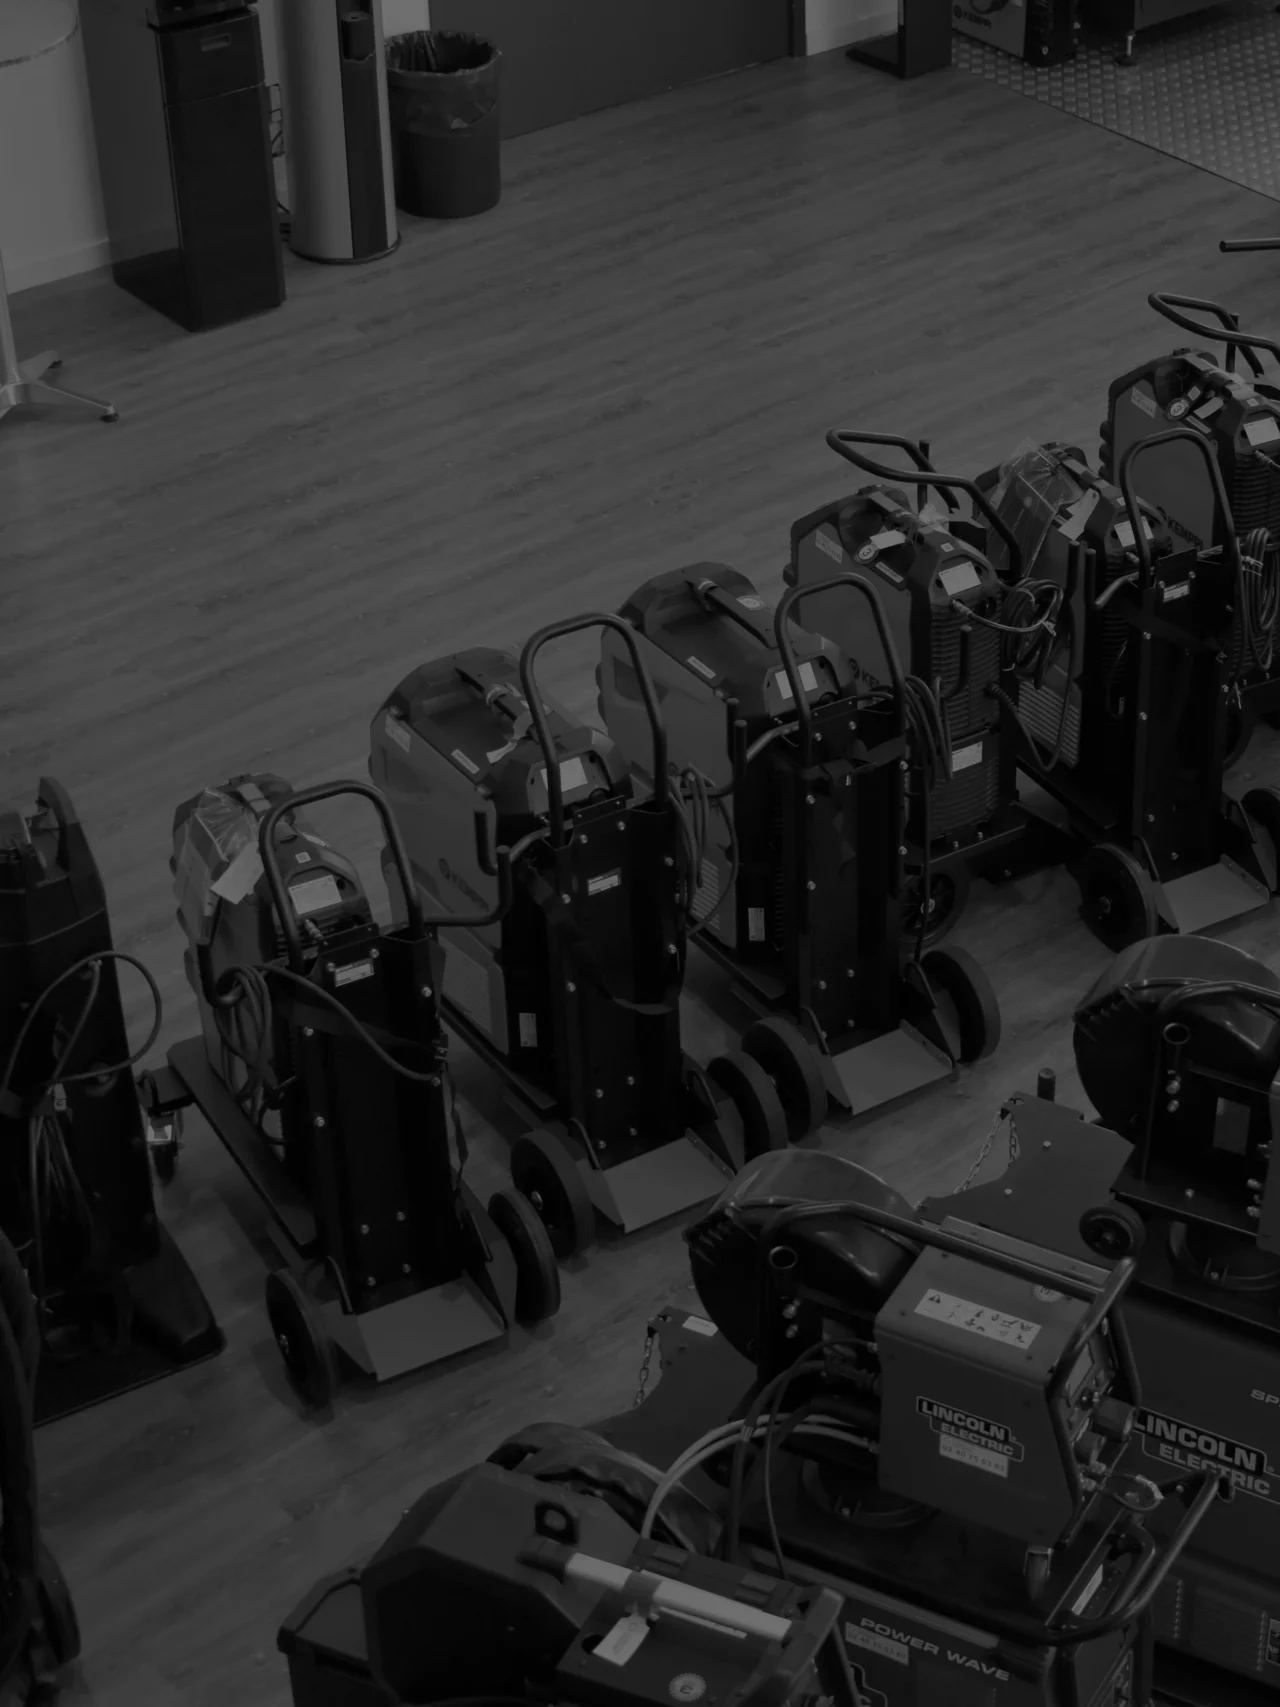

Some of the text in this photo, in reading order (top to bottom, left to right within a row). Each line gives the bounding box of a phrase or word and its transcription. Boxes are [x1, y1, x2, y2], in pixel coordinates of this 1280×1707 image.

[1167, 516, 1204, 550] KEMPPI
[921, 1400, 1006, 1441] LINCOLN
[940, 1421, 1015, 1456] ELECTRIC
[1159, 1442, 1270, 1496] ELECTRIC
[860, 1616, 1011, 1682] POWER WAVE
